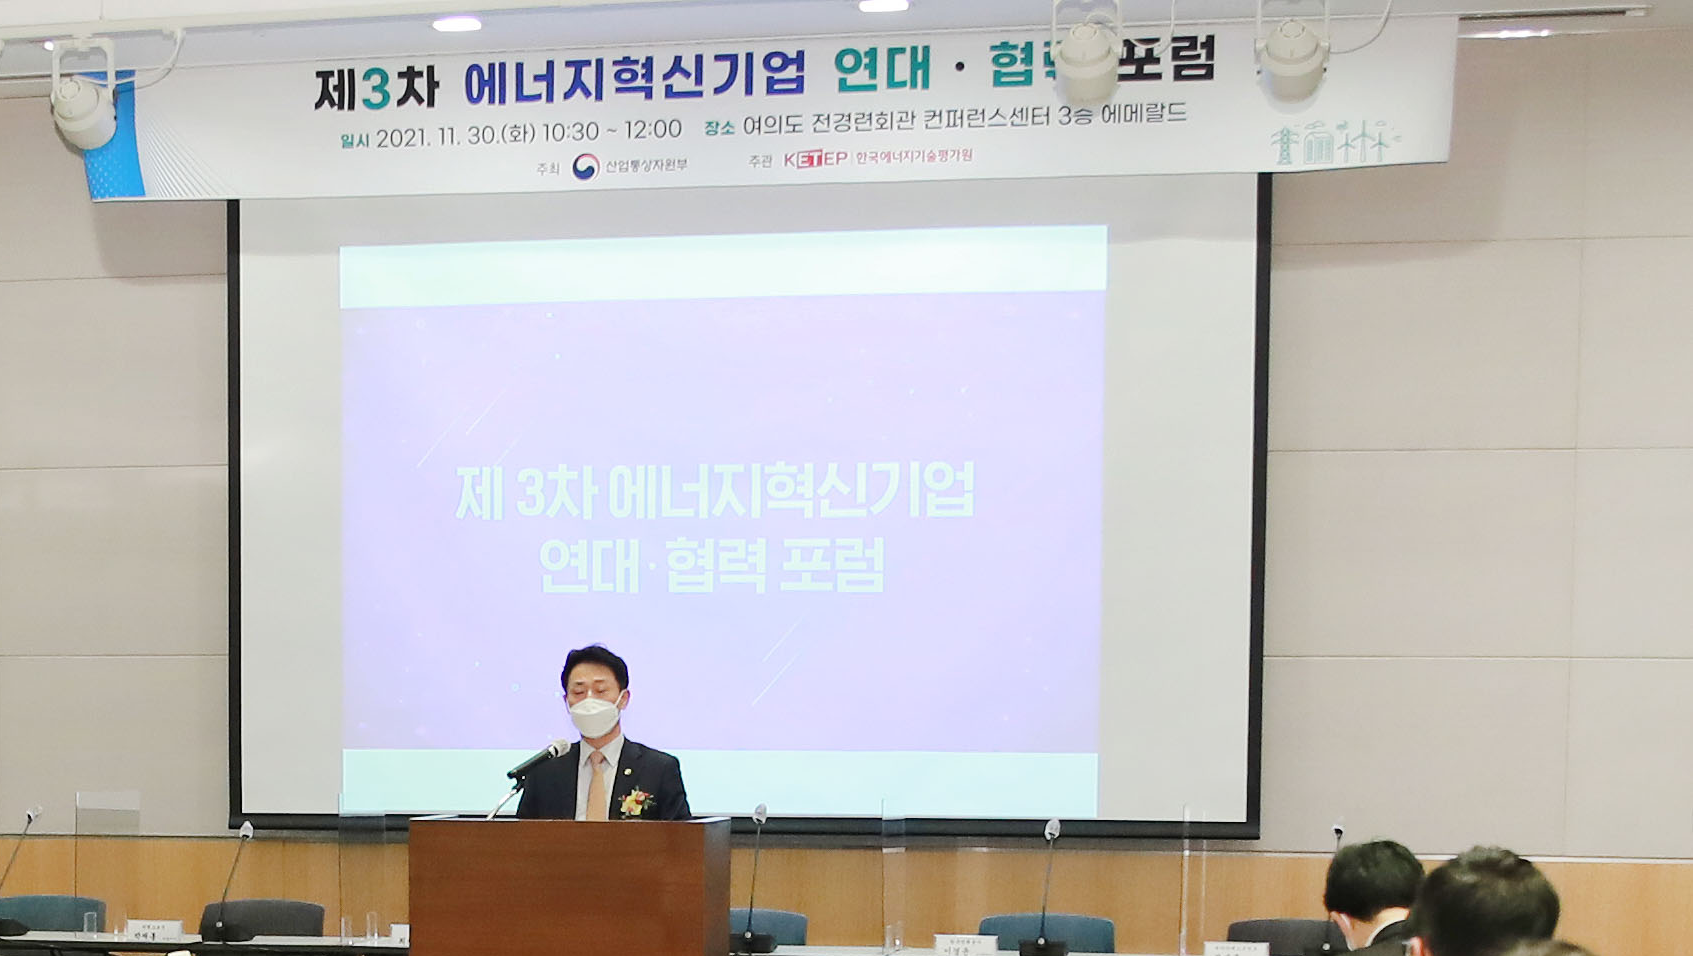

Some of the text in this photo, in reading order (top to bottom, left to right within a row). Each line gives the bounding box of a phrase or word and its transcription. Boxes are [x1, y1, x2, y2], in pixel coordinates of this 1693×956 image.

[314, 64, 440, 111] 제3차
[464, 50, 805, 105] 에너지혁신기업
[834, 45, 931, 93] 연대
[989, 40, 1061, 88] 협
[1117, 34, 1215, 83] 포럼
[340, 133, 370, 149] 일시
[376, 128, 431, 149] 2021.
[438, 126, 460, 147] 11.
[542, 121, 599, 142] 10:30
[624, 118, 682, 139] 12:00
[704, 119, 735, 136] 장소
[743, 114, 804, 135] 여의도
[812, 110, 916, 134] 전경련회관
[924, 105, 1050, 130] 컨퍼런스센터
[1101, 102, 1187, 124] 에메랄드
[537, 158, 688, 176] 주최 산업통상자원부
[748, 148, 973, 170] 주관 KETEP 한국에너지기술평가원
[455, 460, 975, 521] 제 3차 에너지혁신기업
[779, 536, 885, 594] 포럼
